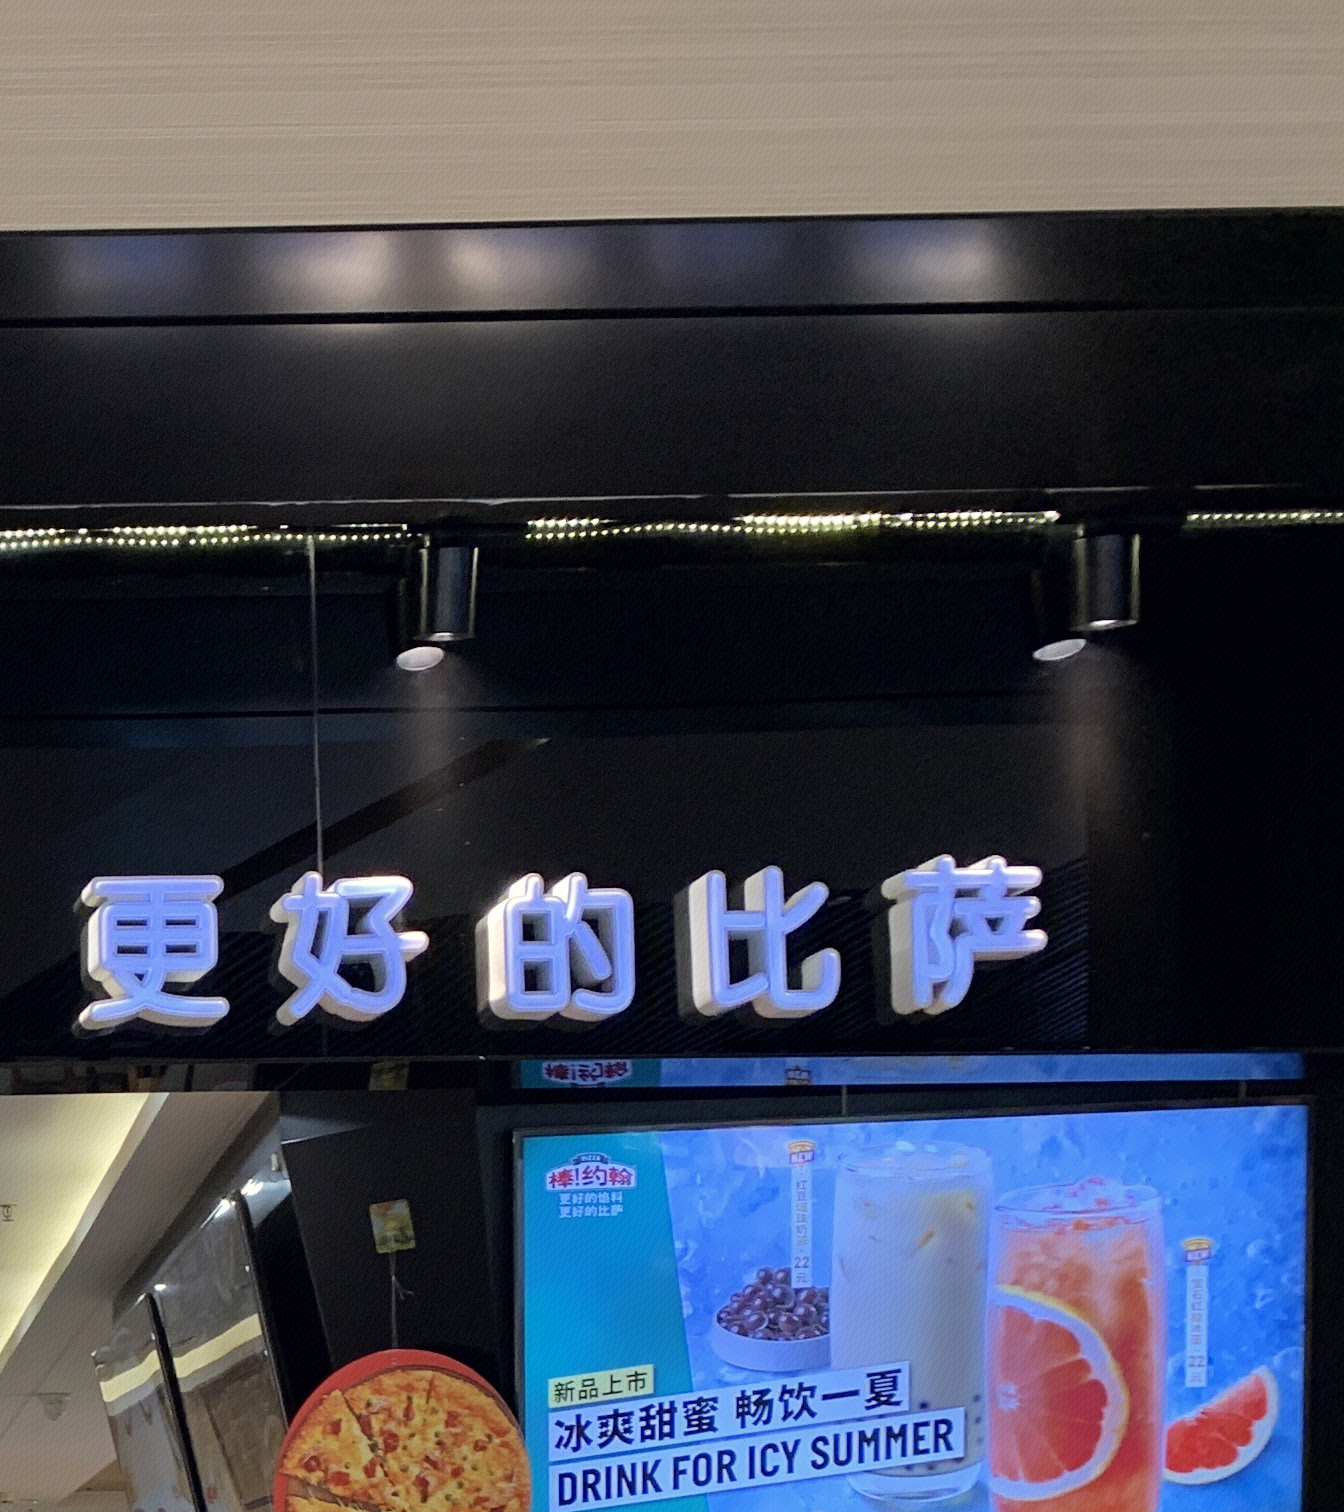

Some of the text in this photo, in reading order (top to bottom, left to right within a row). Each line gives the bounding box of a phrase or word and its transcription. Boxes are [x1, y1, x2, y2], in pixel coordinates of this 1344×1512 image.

[80, 854, 1048, 1026] 更好的比萨
[549, 1167, 634, 1189] 棒!约翰
[559, 1191, 623, 1205] 更好的馅料
[559, 1204, 623, 1219] 更好的比萨
[553, 1370, 649, 1402] 新品上市
[553, 1369, 905, 1454] 冰爽甜蜜 畅饮一夏
[558, 1418, 954, 1507] DRINK FOR ICY SUMMER
